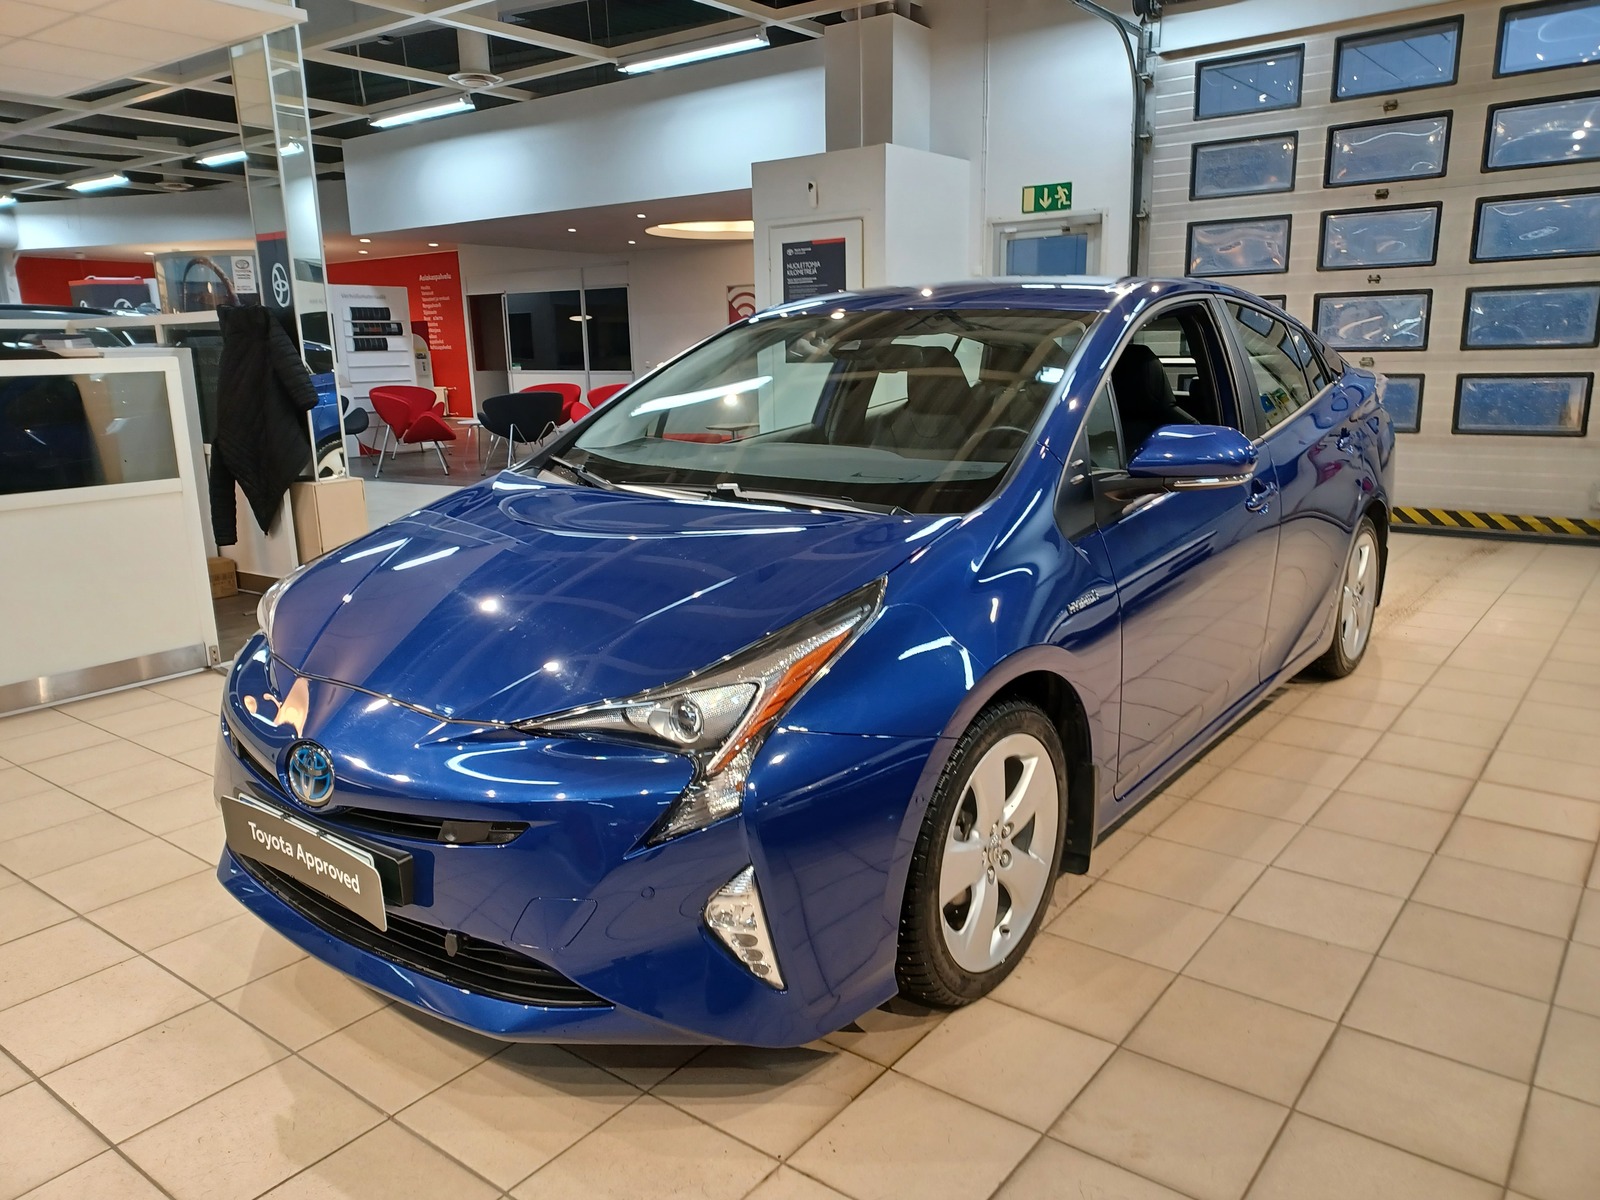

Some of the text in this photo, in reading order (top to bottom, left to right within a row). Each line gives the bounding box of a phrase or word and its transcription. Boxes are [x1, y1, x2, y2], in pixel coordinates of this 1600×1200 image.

[1067, 589, 1100, 615] HYBRID
[247, 821, 361, 895] Toyota Approved
